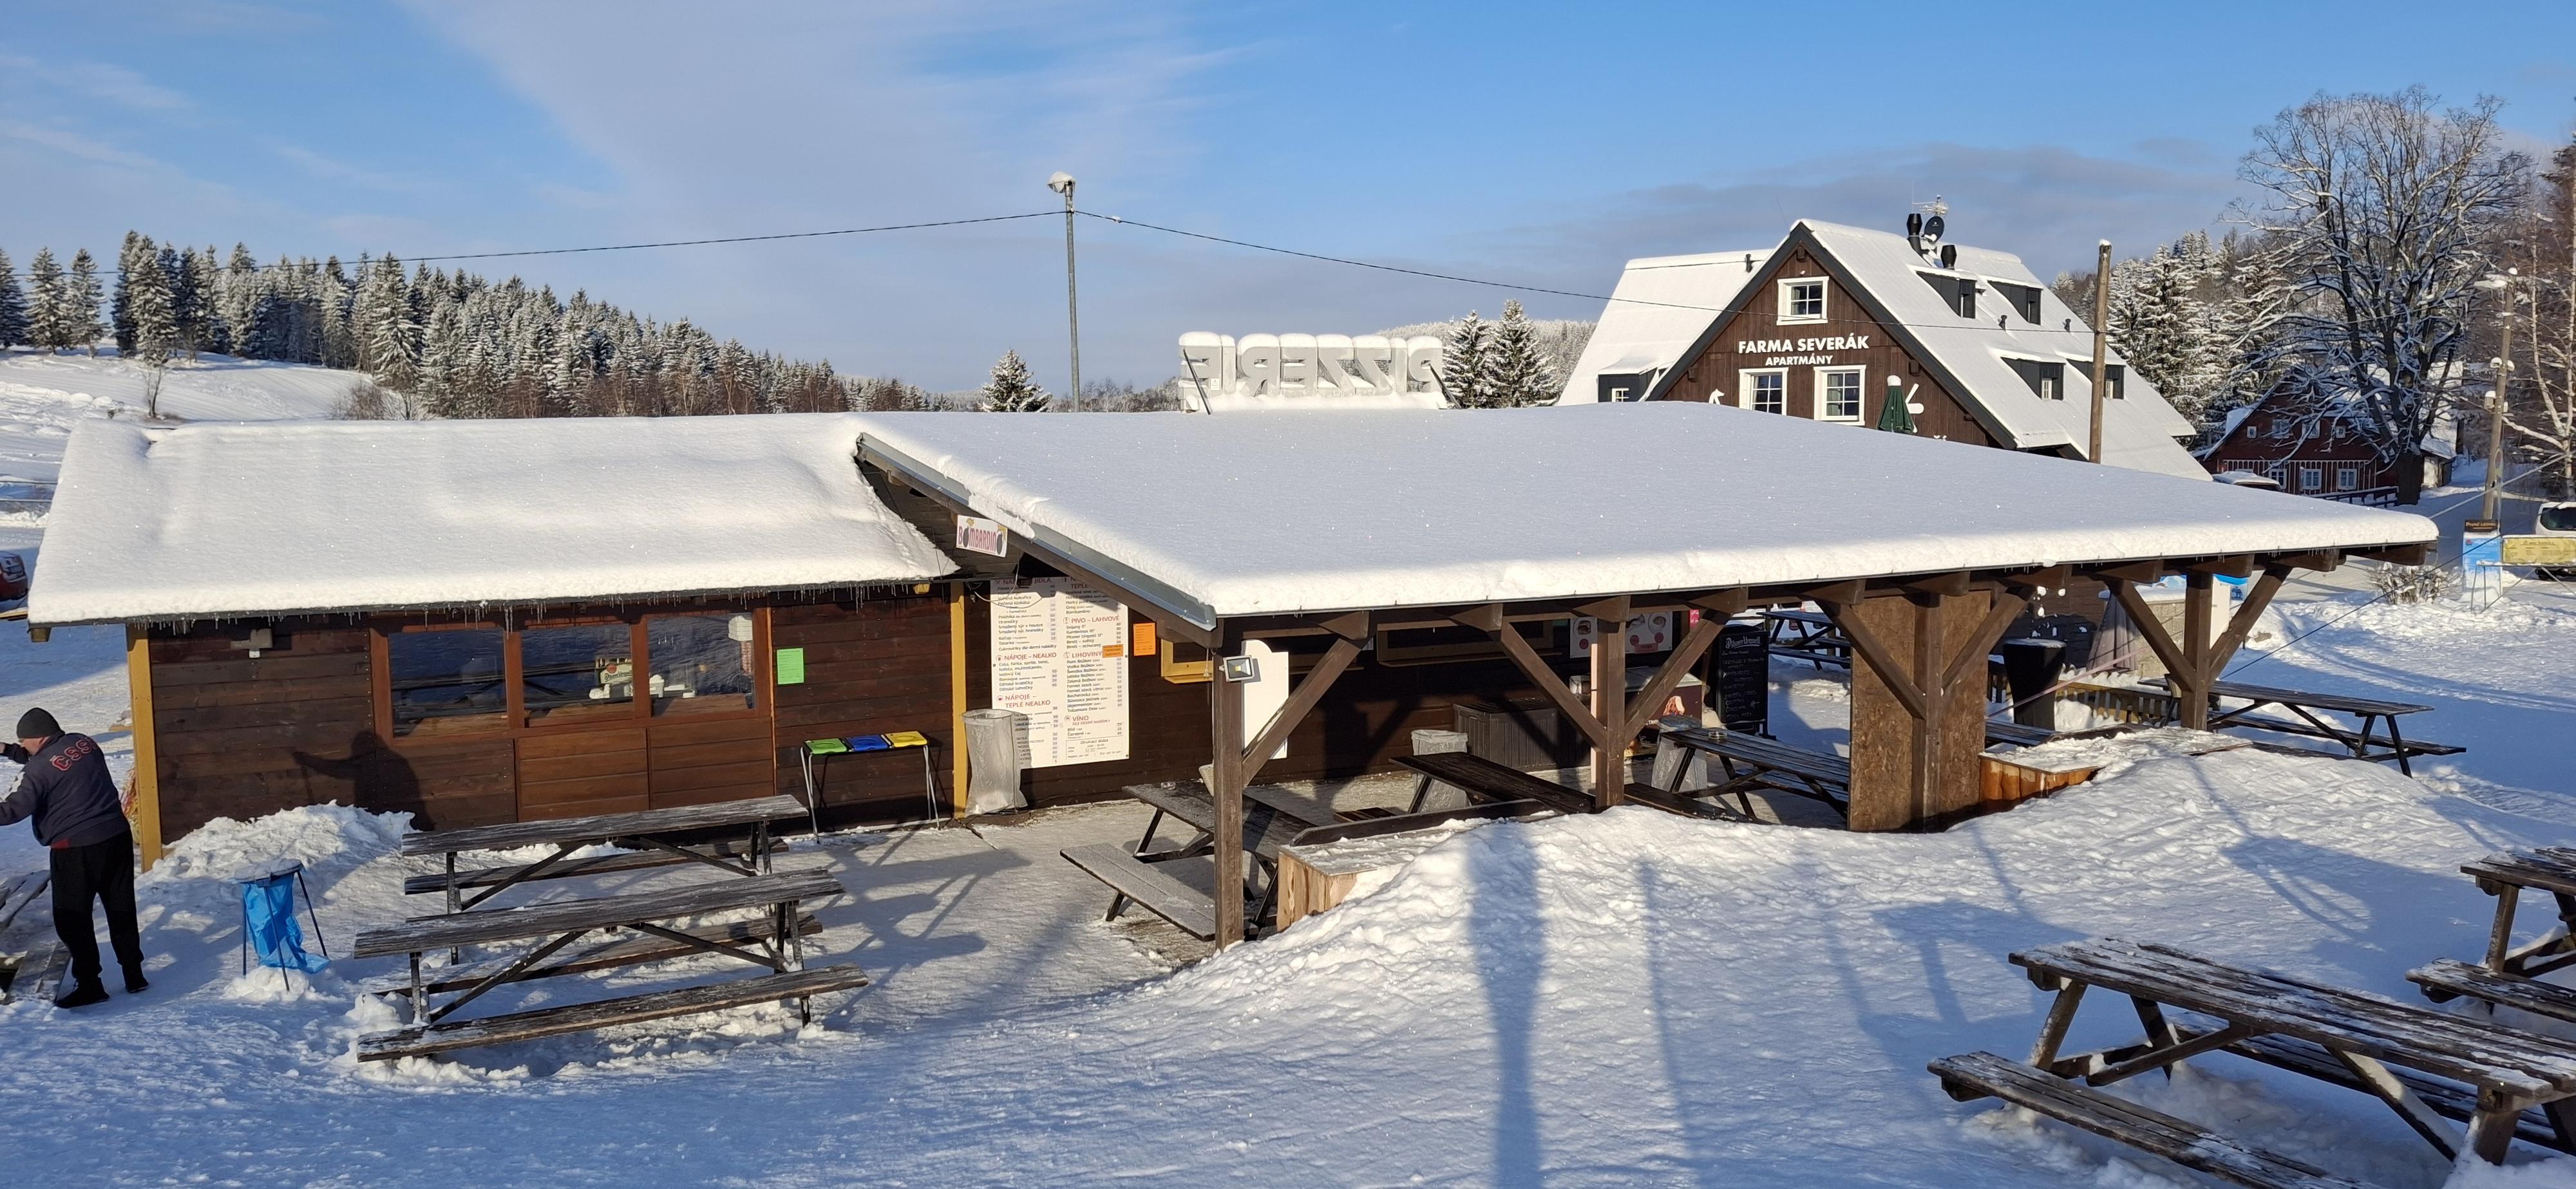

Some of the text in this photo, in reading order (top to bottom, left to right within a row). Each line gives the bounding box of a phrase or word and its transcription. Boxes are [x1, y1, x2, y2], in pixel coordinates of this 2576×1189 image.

[1738, 332, 1870, 354] FARMA SEVERÁK
[1765, 353, 1833, 366] APARTMÁNY
[958, 526, 1003, 555] BOMBARDINO
